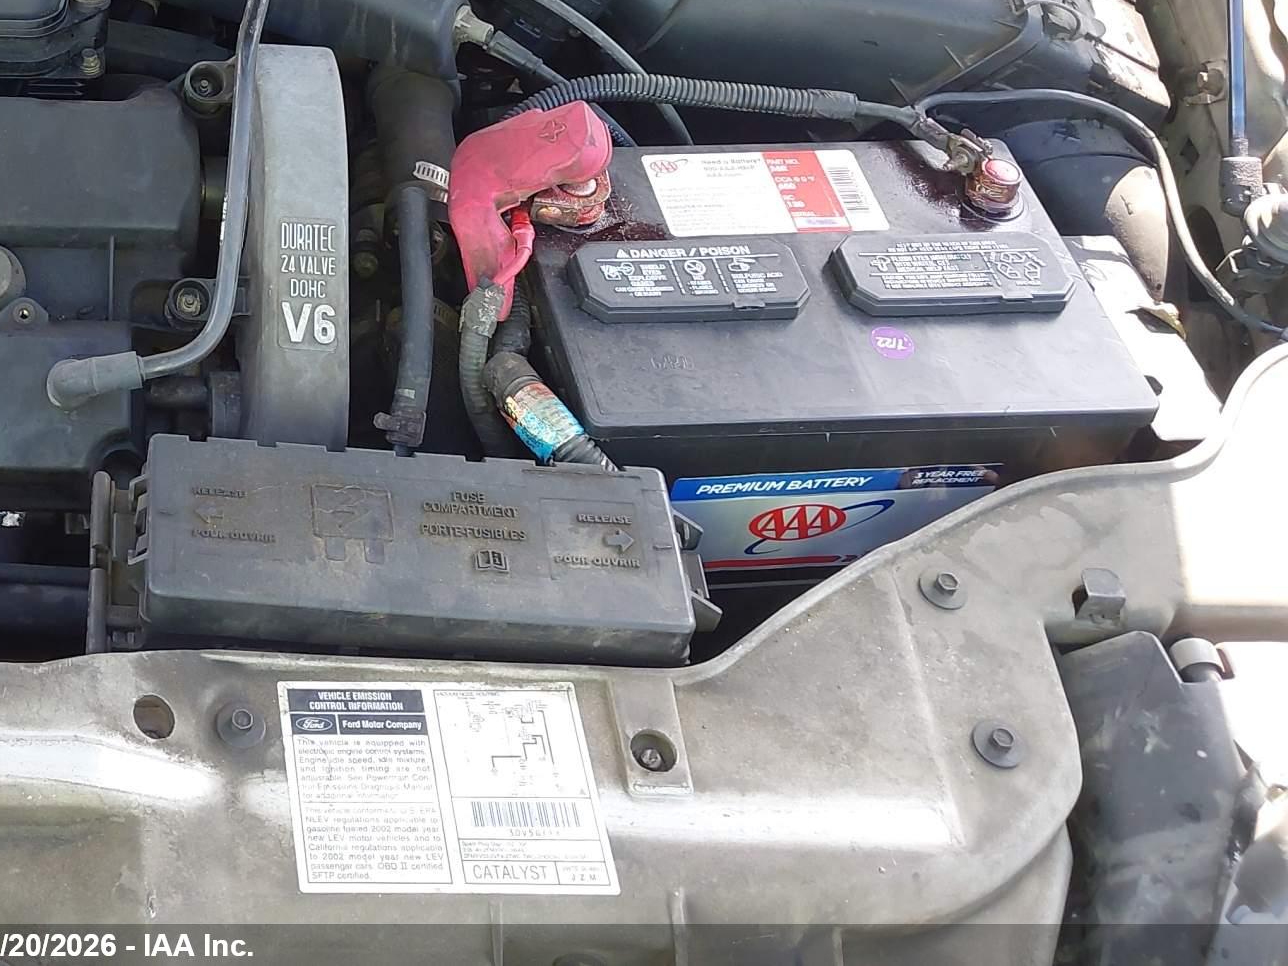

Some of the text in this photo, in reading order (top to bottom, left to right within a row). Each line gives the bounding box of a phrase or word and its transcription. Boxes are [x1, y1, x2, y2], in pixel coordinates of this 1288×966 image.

[281, 222, 336, 252] DURATEC
[629, 249, 686, 258] DANGER
[699, 245, 751, 256] POISON
[280, 254, 336, 276] 24 VALVE
[290, 278, 326, 299] DOHC
[281, 301, 336, 344] V6
[924, 470, 957, 479] YEAR
[957, 468, 988, 478] FREE
[695, 475, 873, 496] PREMIUM BATTERY
[912, 476, 983, 486] REPLACEMENT
[451, 491, 486, 503] FUSE
[423, 501, 519, 518] COMPARTMENT
[577, 513, 633, 525] RELEASE
[758, 506, 840, 539] AAA
[420, 524, 527, 541] PORTE-FUSIBLES
[554, 554, 641, 568] POUR OUVRIR
[317, 691, 393, 701] VEHICLE EMISSION
[309, 701, 404, 711] CONTROL INFORMATION
[342, 720, 422, 731] Ford Motor Company
[319, 739, 349, 747] vehicle
[365, 739, 405, 748] equipped
[409, 739, 426, 747] with
[299, 756, 326, 764] Engine
[300, 765, 316, 773] and
[321, 765, 355, 774] ignition
[361, 765, 390, 774] timing
[416, 765, 430, 773] not
[371, 825, 392, 833] 2002
[394, 825, 419, 833] model
[307, 834, 325, 842] new
[328, 834, 345, 842] LEV
[376, 834, 410, 842] vehicles
[414, 834, 430, 842] and
[351, 843, 397, 852] regulations
[309, 853, 318, 861] to
[322, 853, 344, 861] 2002
[403, 853, 422, 861] new
[426, 853, 444, 861] LEV
[310, 863, 353, 871] passenger
[400, 863, 408, 871] II
[472, 864, 548, 881] CATALYST
[311, 872, 335, 880] SFTP
